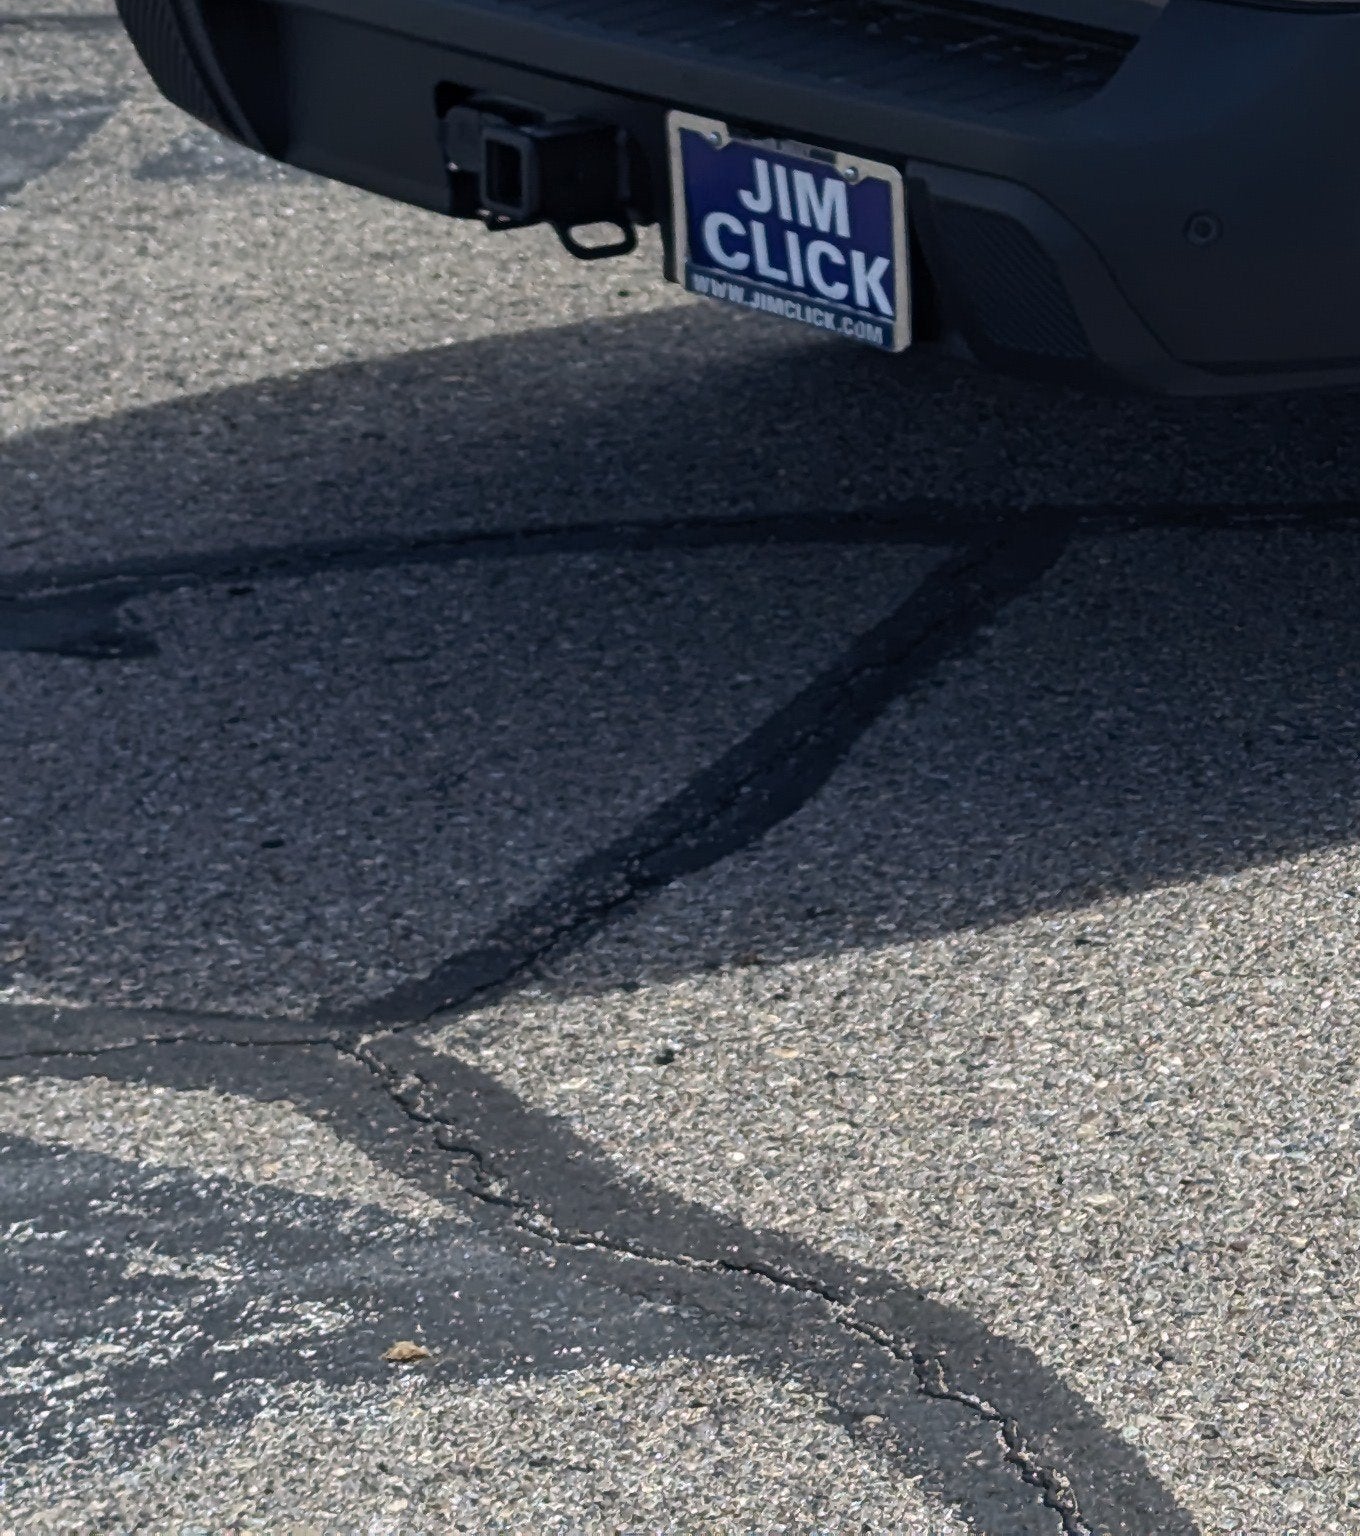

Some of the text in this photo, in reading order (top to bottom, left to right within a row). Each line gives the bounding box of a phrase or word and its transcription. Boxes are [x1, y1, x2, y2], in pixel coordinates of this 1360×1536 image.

[738, 158, 850, 238] JIM
[704, 212, 893, 315] CLICK
[693, 274, 884, 346] WWW.JIMCLICK.COM
